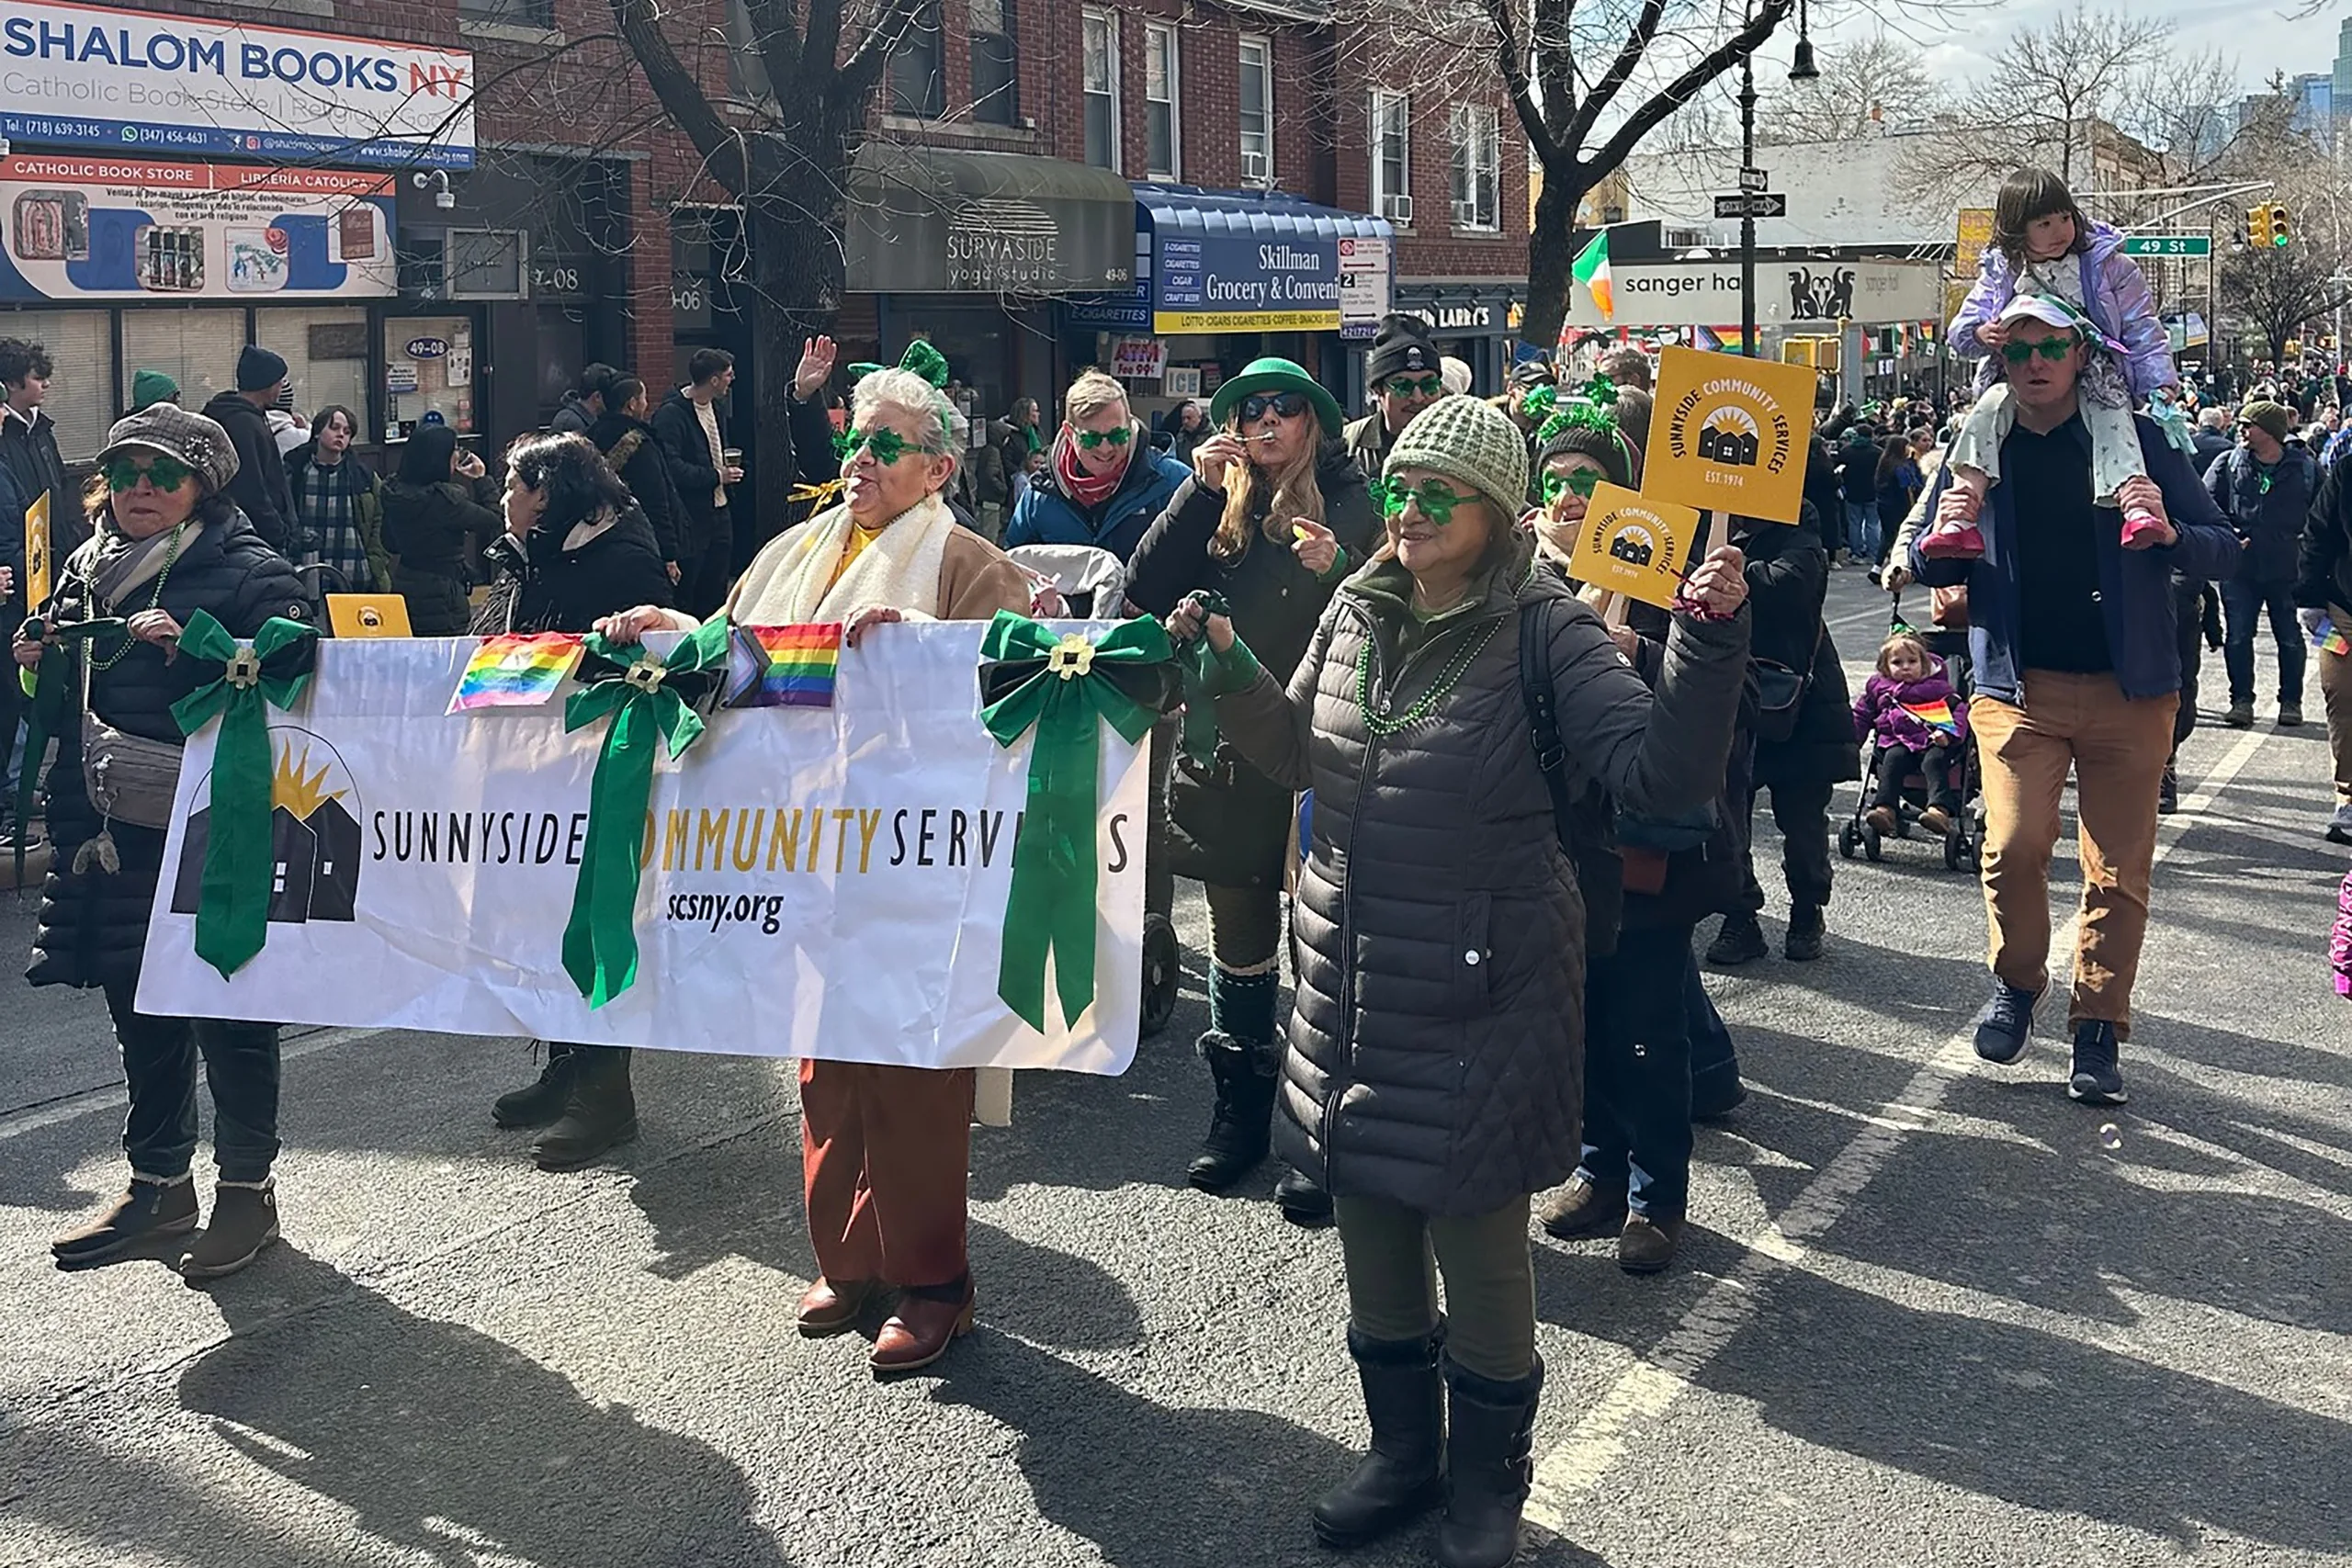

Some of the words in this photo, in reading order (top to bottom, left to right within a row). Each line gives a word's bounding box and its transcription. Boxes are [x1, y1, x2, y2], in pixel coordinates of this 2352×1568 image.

[4, 17, 224, 75] SHALOM
[241, 43, 398, 92] BOOKS
[410, 62, 465, 98] NY
[4, 72, 119, 103] Catholic
[129, 83, 197, 108] Book
[26, 119, 52, 136] (718)
[54, 122, 100, 137] 639-3145
[140, 129, 165, 144] (347)
[15, 161, 95, 177] CATHOLIC
[98, 165, 142, 180] BOOK
[146, 168, 194, 182] STORE
[1752, 201, 1775, 211] WAY
[947, 235, 1057, 262] SURYASIDE
[1259, 243, 1320, 270] Skillman
[2139, 240, 2161, 253] 49
[2168, 240, 2186, 253] St
[950, 267, 991, 286] yoga
[1003, 265, 1057, 280] studio
[1171, 276, 1193, 287] CIGAR
[1343, 274, 1352, 288] 2
[1625, 275, 1704, 297] sanger
[1713, 273, 1741, 291] ha
[1165, 292, 1184, 303] CRAFT
[1206, 274, 1267, 308] Grocery
[1271, 276, 1282, 300] &
[1286, 275, 1339, 300] Conveni
[1071, 307, 1147, 321] E-CIGARETTES
[1114, 341, 1159, 363] ATM
[1117, 364, 1133, 375] Fee
[1169, 372, 1198, 393] ICE
[1669, 389, 1702, 459] SUNNYSIDE
[1702, 378, 1780, 413] COMMUNITY
[1767, 413, 1790, 475] SERVICES
[1704, 469, 1744, 488] EST.1974
[1592, 511, 1619, 554] SUNNYSIDE
[1619, 506, 1670, 535] COMMUNITY
[1656, 536, 1675, 575] SERVICES
[373, 810, 588, 865] SUNNYSIDE
[639, 807, 882, 874] OMMUNITY
[889, 808, 1128, 874] SERVIS
[667, 893, 785, 935] scsny.org
